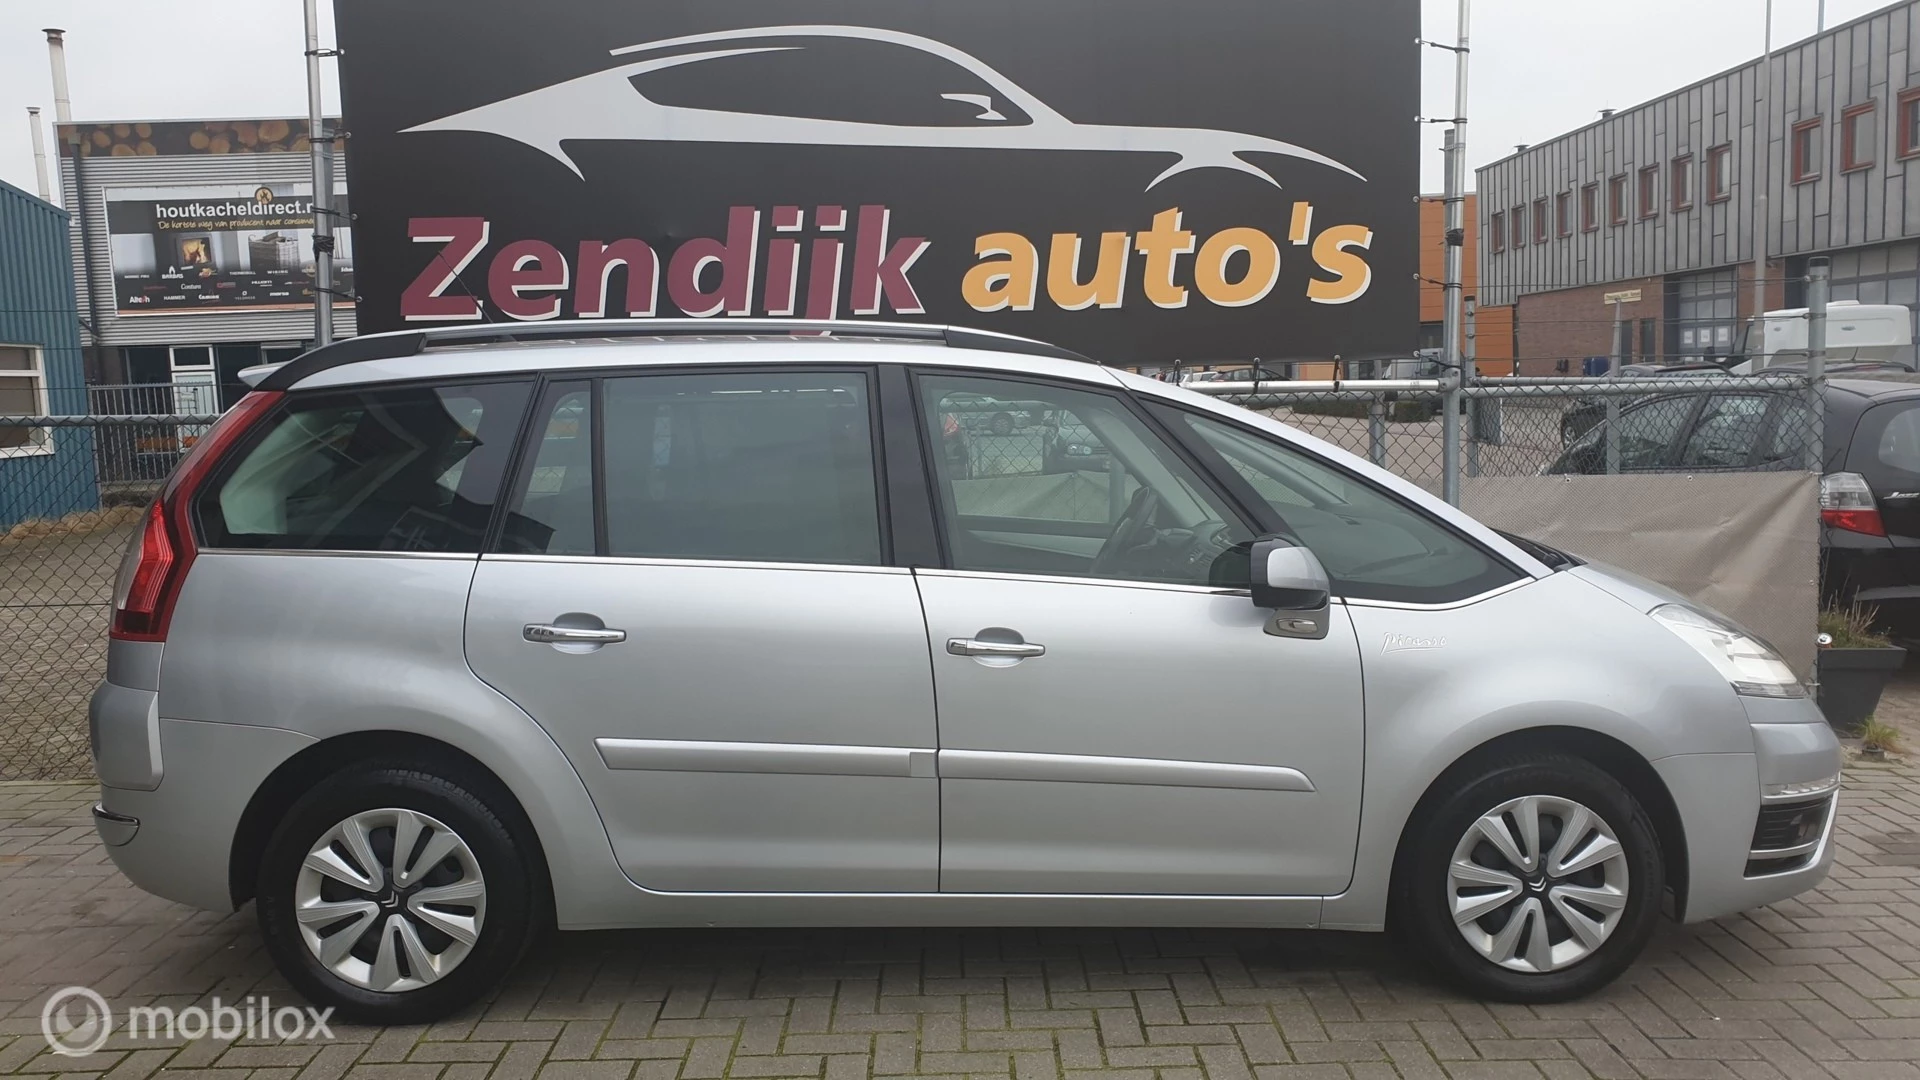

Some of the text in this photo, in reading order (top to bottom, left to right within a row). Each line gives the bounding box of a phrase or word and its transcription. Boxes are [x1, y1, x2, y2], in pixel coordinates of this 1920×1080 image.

[156, 201, 314, 218] houtkacheldirect.n
[158, 221, 170, 229] De
[198, 221, 213, 231] weg
[229, 218, 264, 230] producent
[284, 217, 315, 226] consume
[401, 201, 1374, 336] Zendijk auto's
[1381, 631, 1448, 656] Picasso
